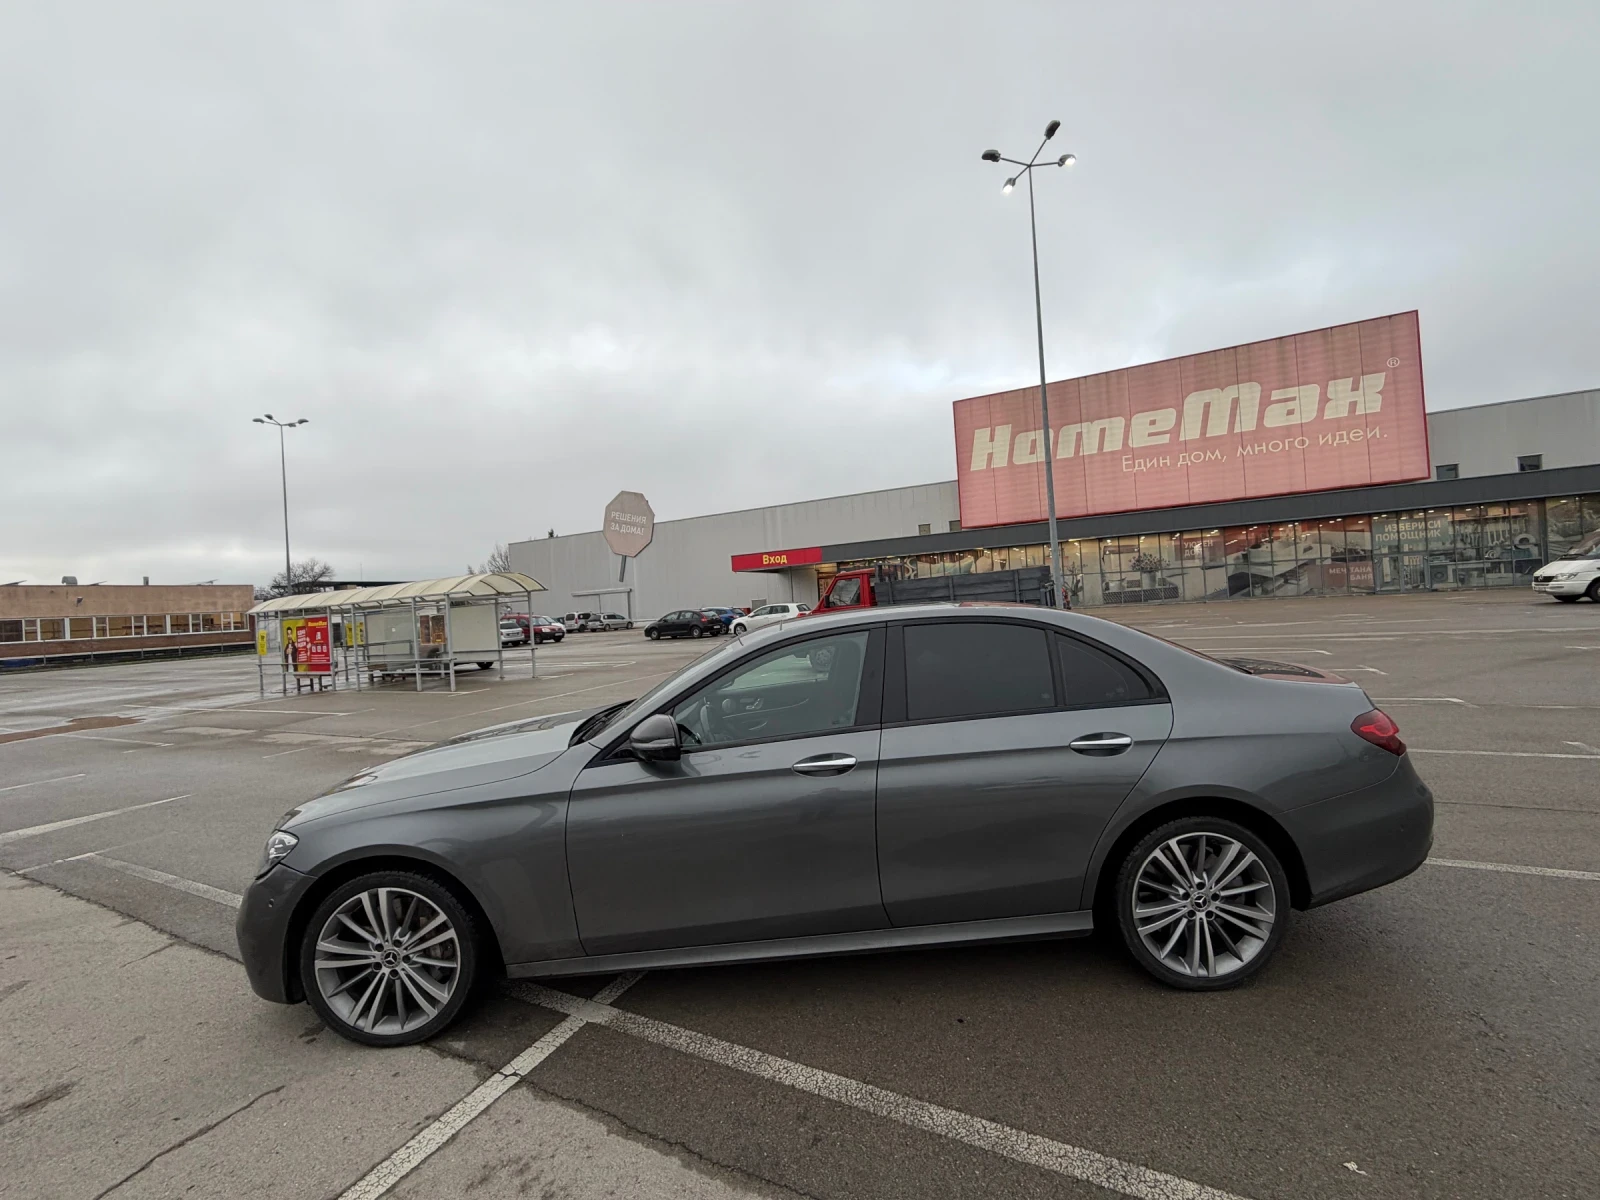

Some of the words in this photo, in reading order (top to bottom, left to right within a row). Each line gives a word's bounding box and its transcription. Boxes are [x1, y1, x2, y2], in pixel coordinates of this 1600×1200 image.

[970, 371, 1386, 471] HomeMax
[1122, 454, 1170, 472] Един
[1178, 448, 1227, 466] дом,
[1236, 436, 1309, 457] много
[1318, 425, 1388, 448] идеи.
[611, 511, 647, 524] РЕШЕНИЯ
[610, 522, 620, 532] ЗА
[1375, 529, 1441, 542] ПОМОЩНИК
[762, 554, 788, 565] Вход
